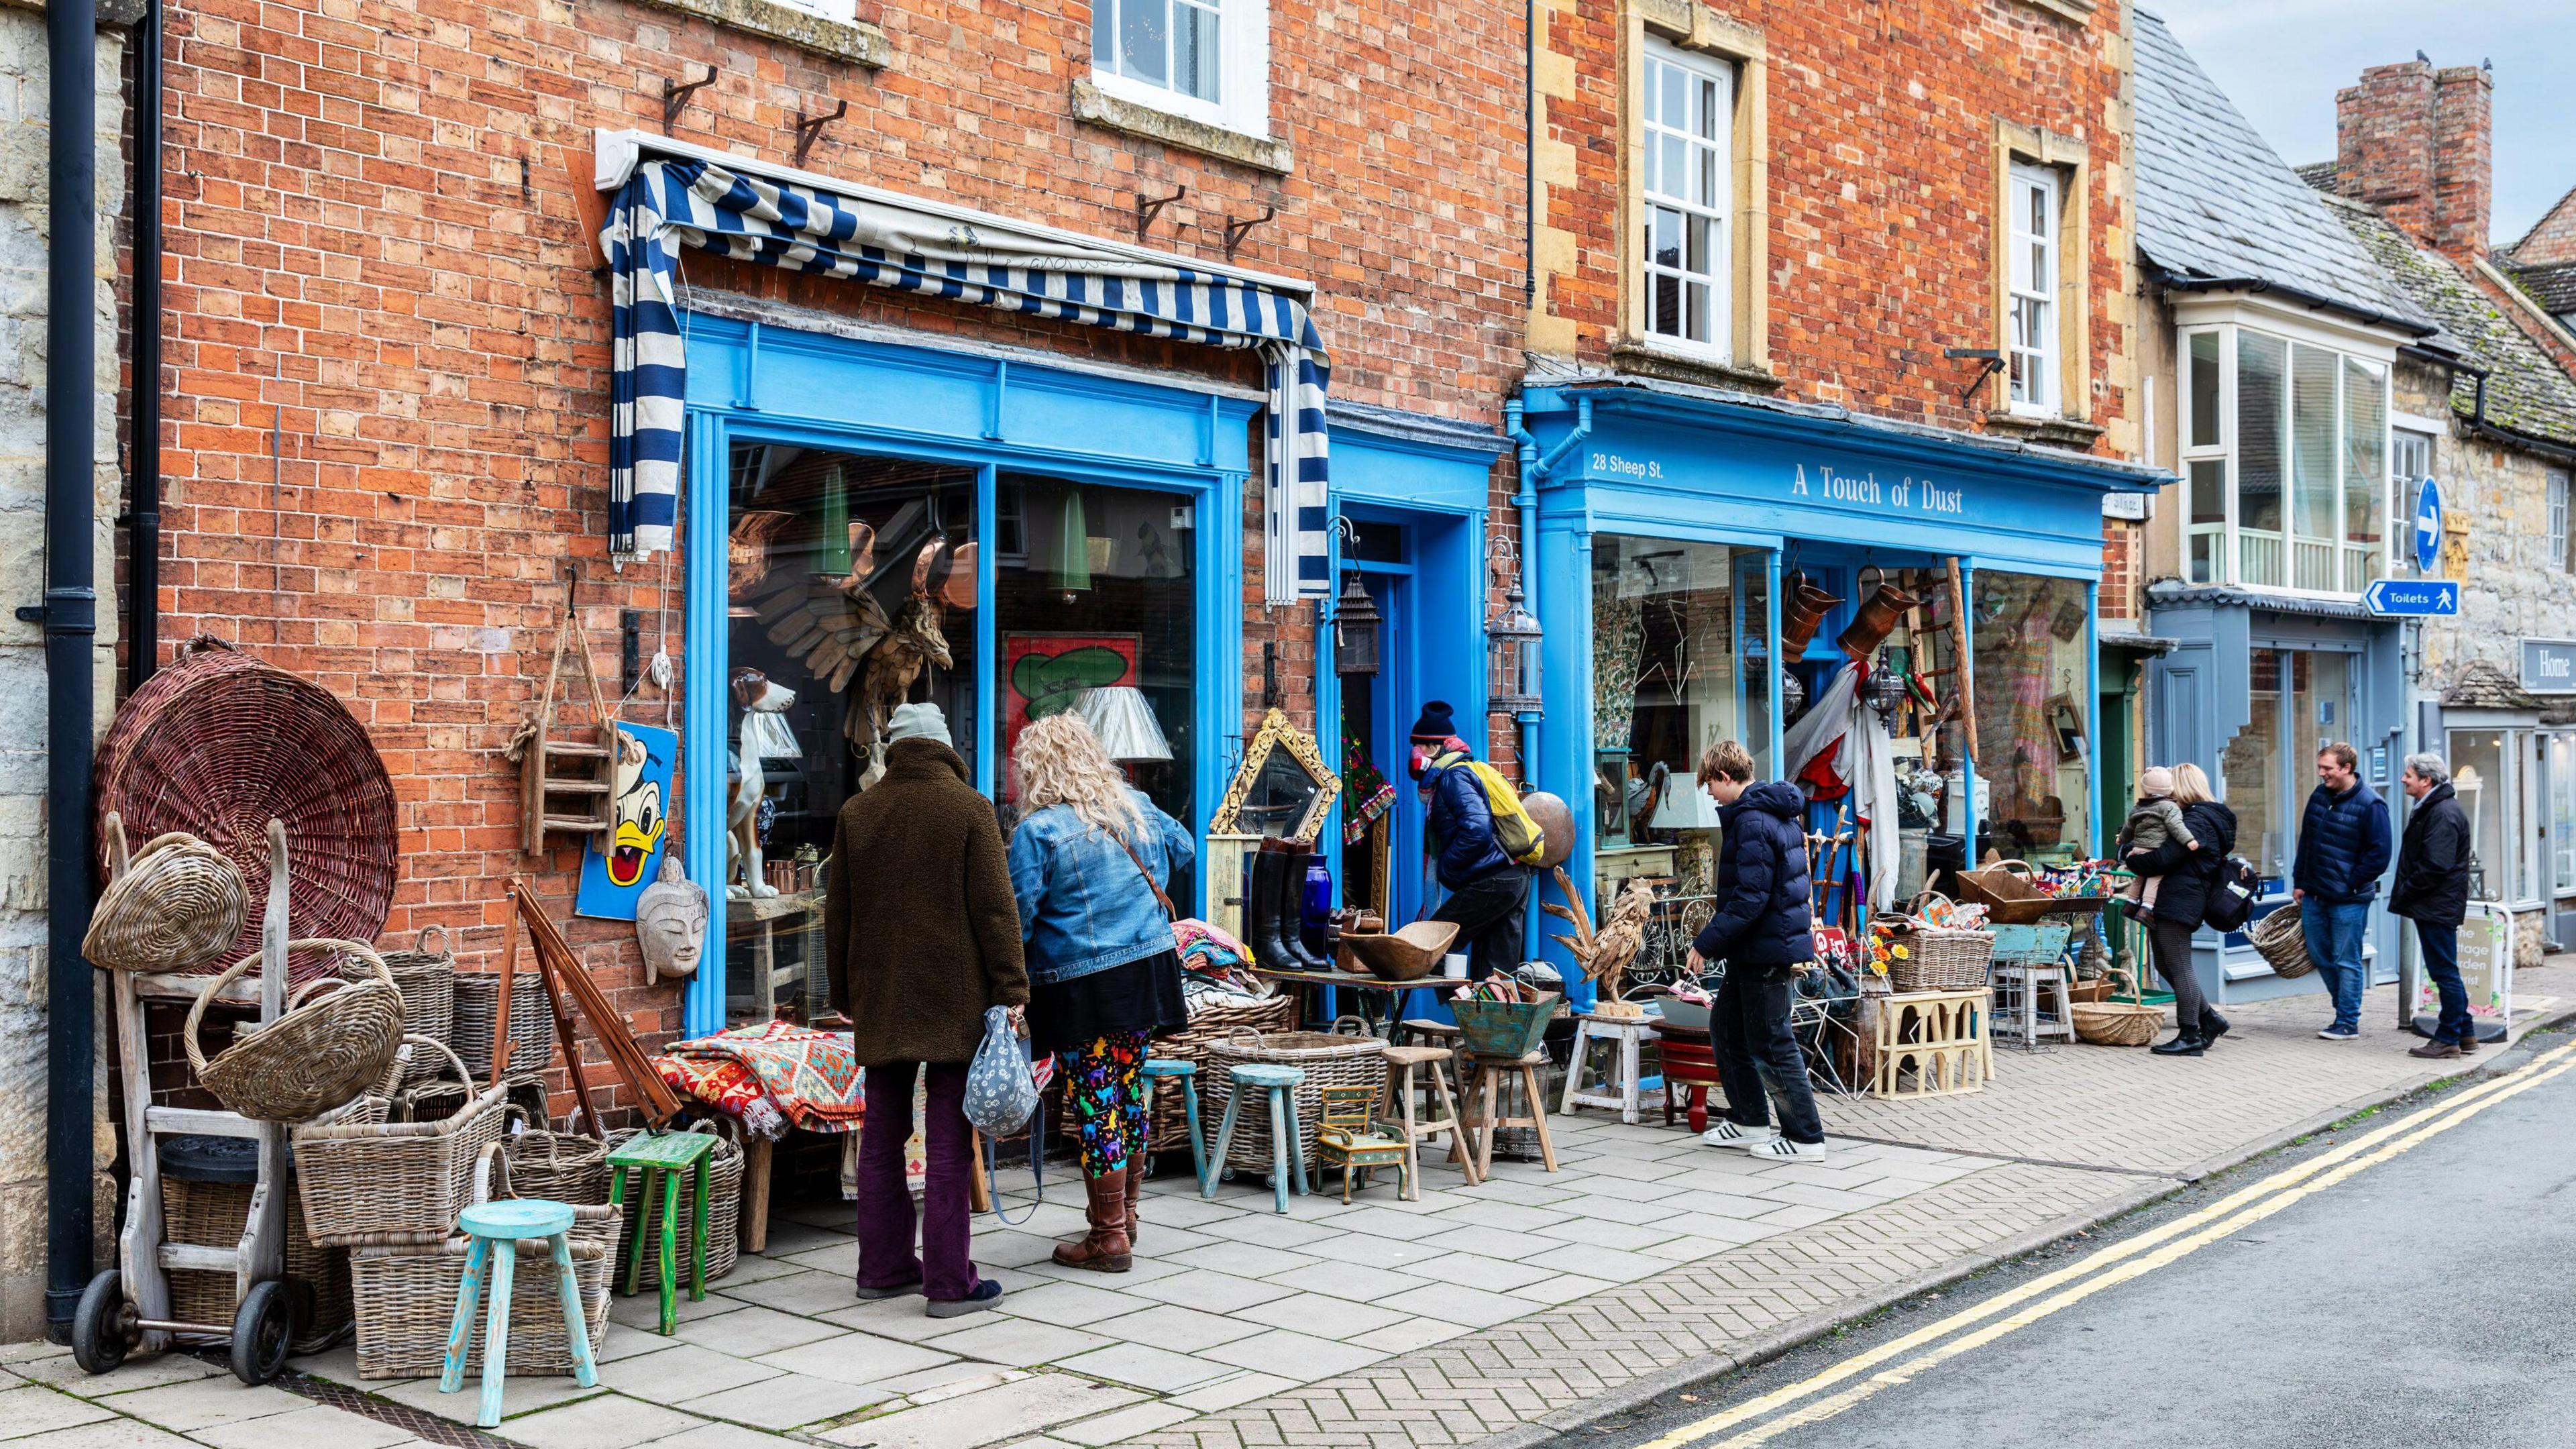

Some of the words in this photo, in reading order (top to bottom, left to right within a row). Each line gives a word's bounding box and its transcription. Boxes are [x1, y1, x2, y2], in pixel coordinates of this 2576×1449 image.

[1592, 453, 1607, 471] 28
[1609, 455, 1646, 479] Sheep
[1648, 461, 1664, 478] St.
[1792, 464, 1809, 496] A
[1819, 466, 1881, 505] Touch
[1891, 476, 1912, 508] of
[1921, 480, 1963, 513] Dust
[2390, 593, 2430, 604] Toilets
[2539, 649, 2571, 677] Home
[2456, 943, 2489, 957] ttage
[2457, 958, 2487, 971] rden
[2461, 974, 2479, 985] rist
